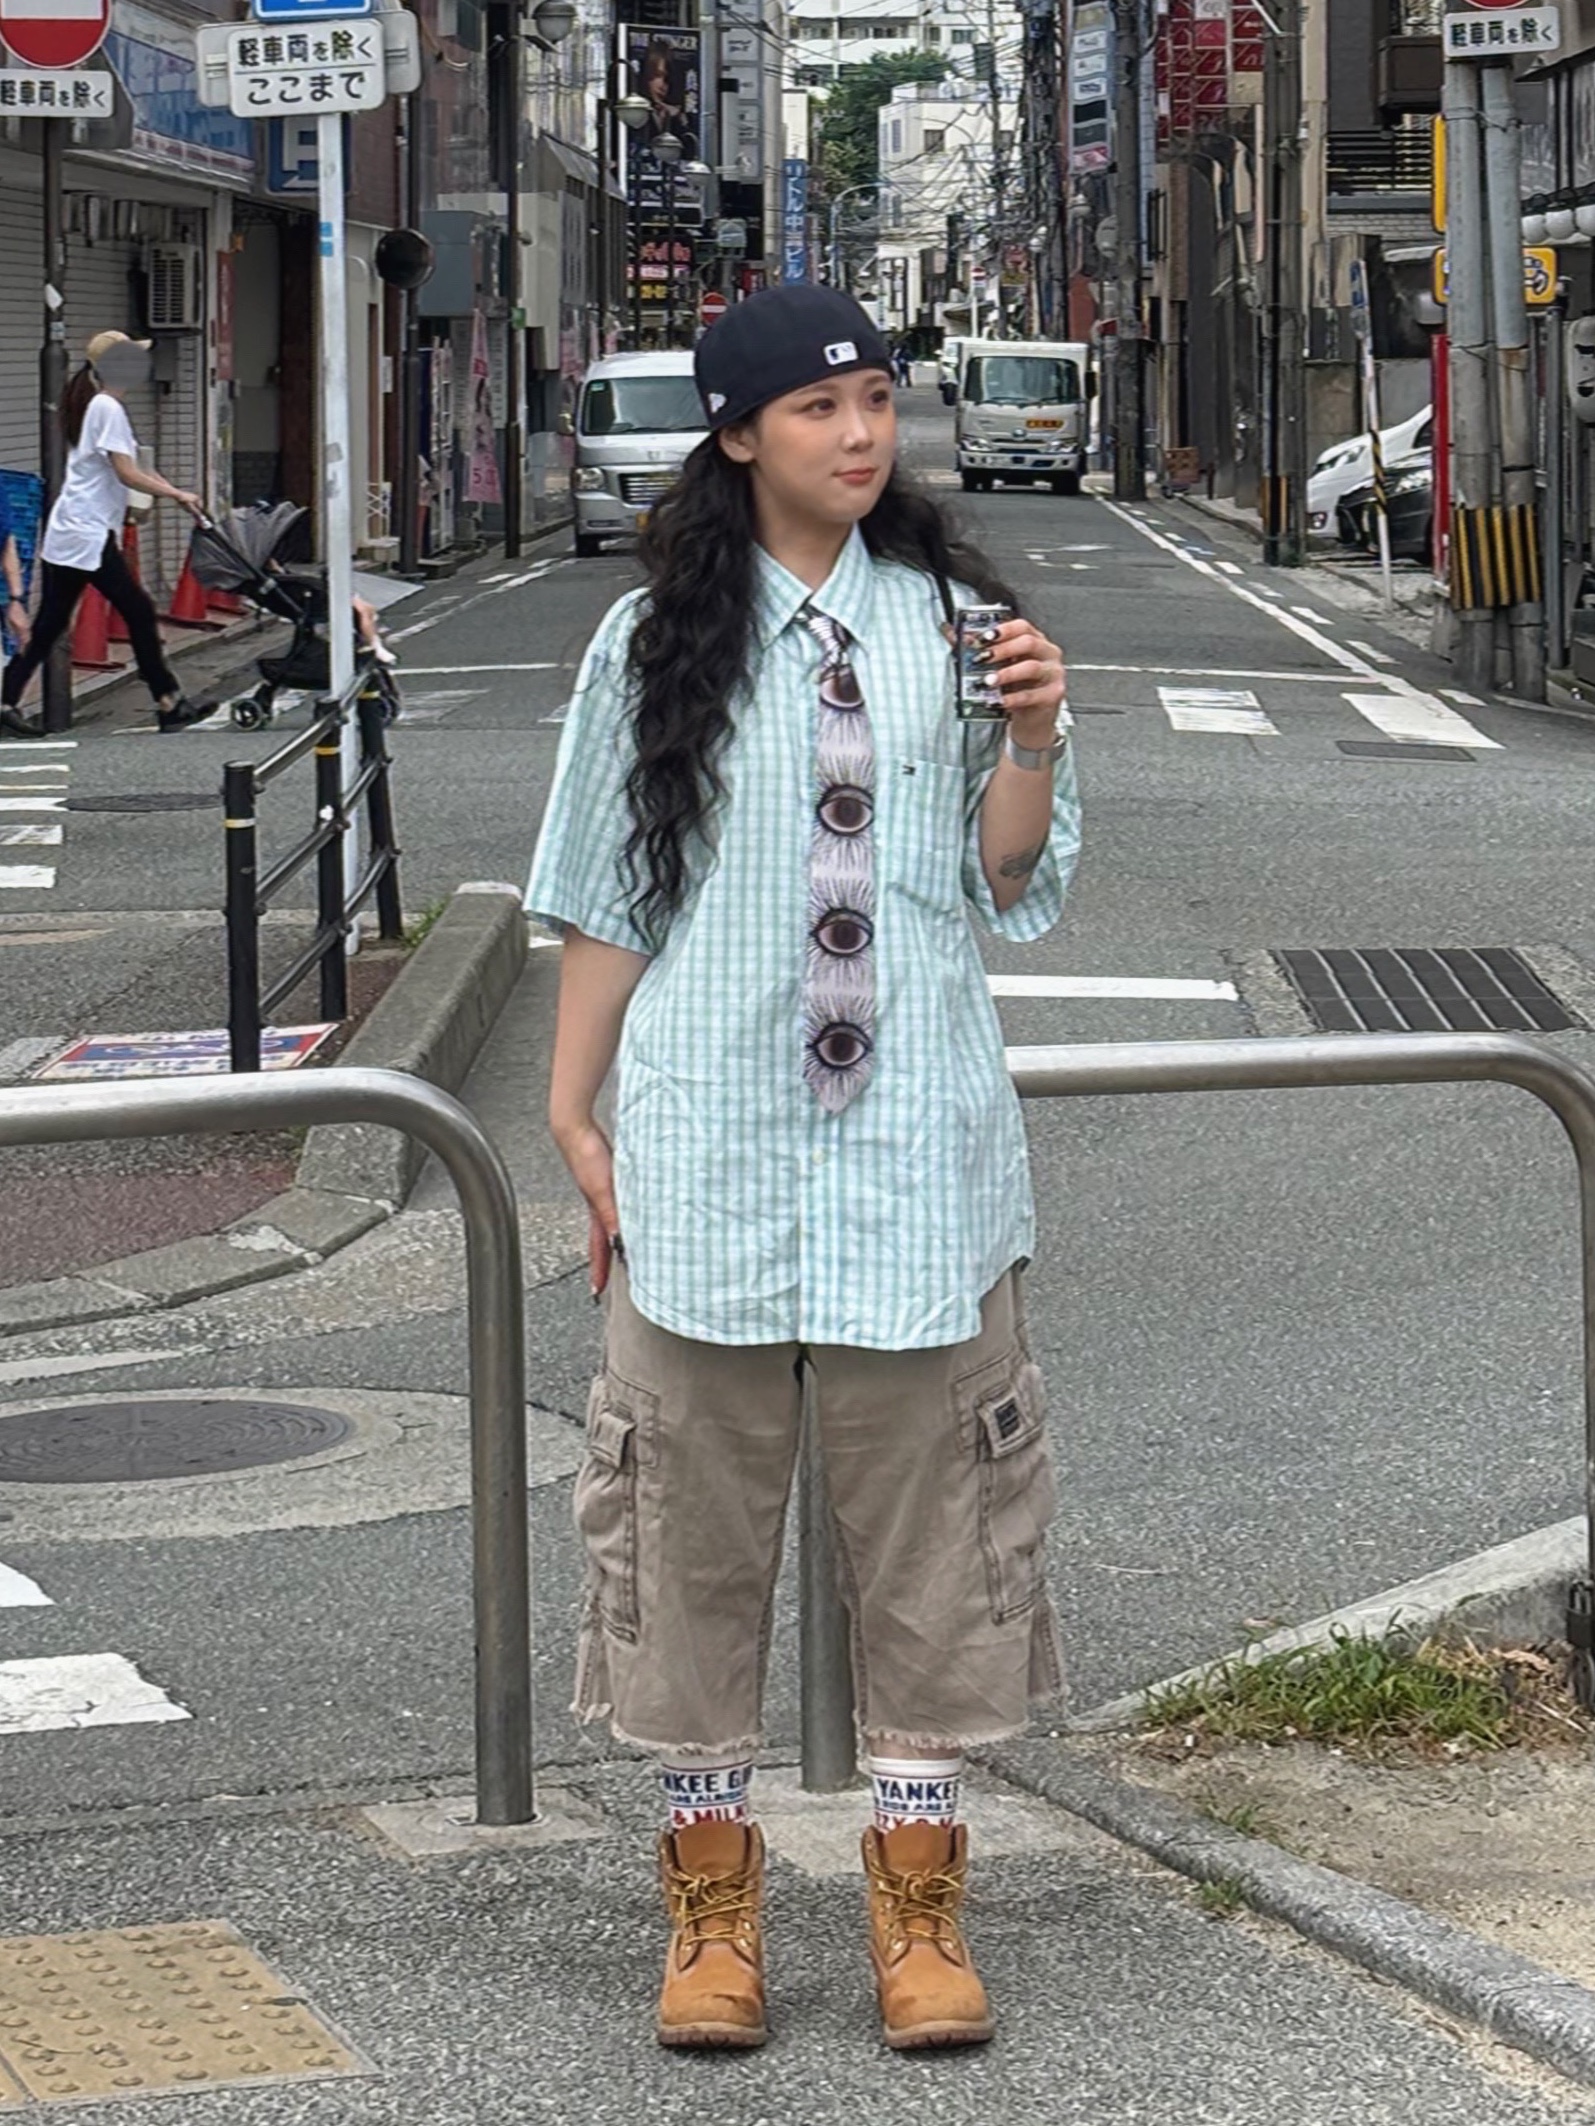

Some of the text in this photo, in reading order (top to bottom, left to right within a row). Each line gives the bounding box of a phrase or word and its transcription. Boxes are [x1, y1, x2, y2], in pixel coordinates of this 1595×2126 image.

[1451, 18, 1553, 47] 軽車両を除く
[238, 30, 373, 67] 軽車両を除く
[0, 80, 106, 108] 軽車両を除く
[248, 72, 365, 105] ここまで
